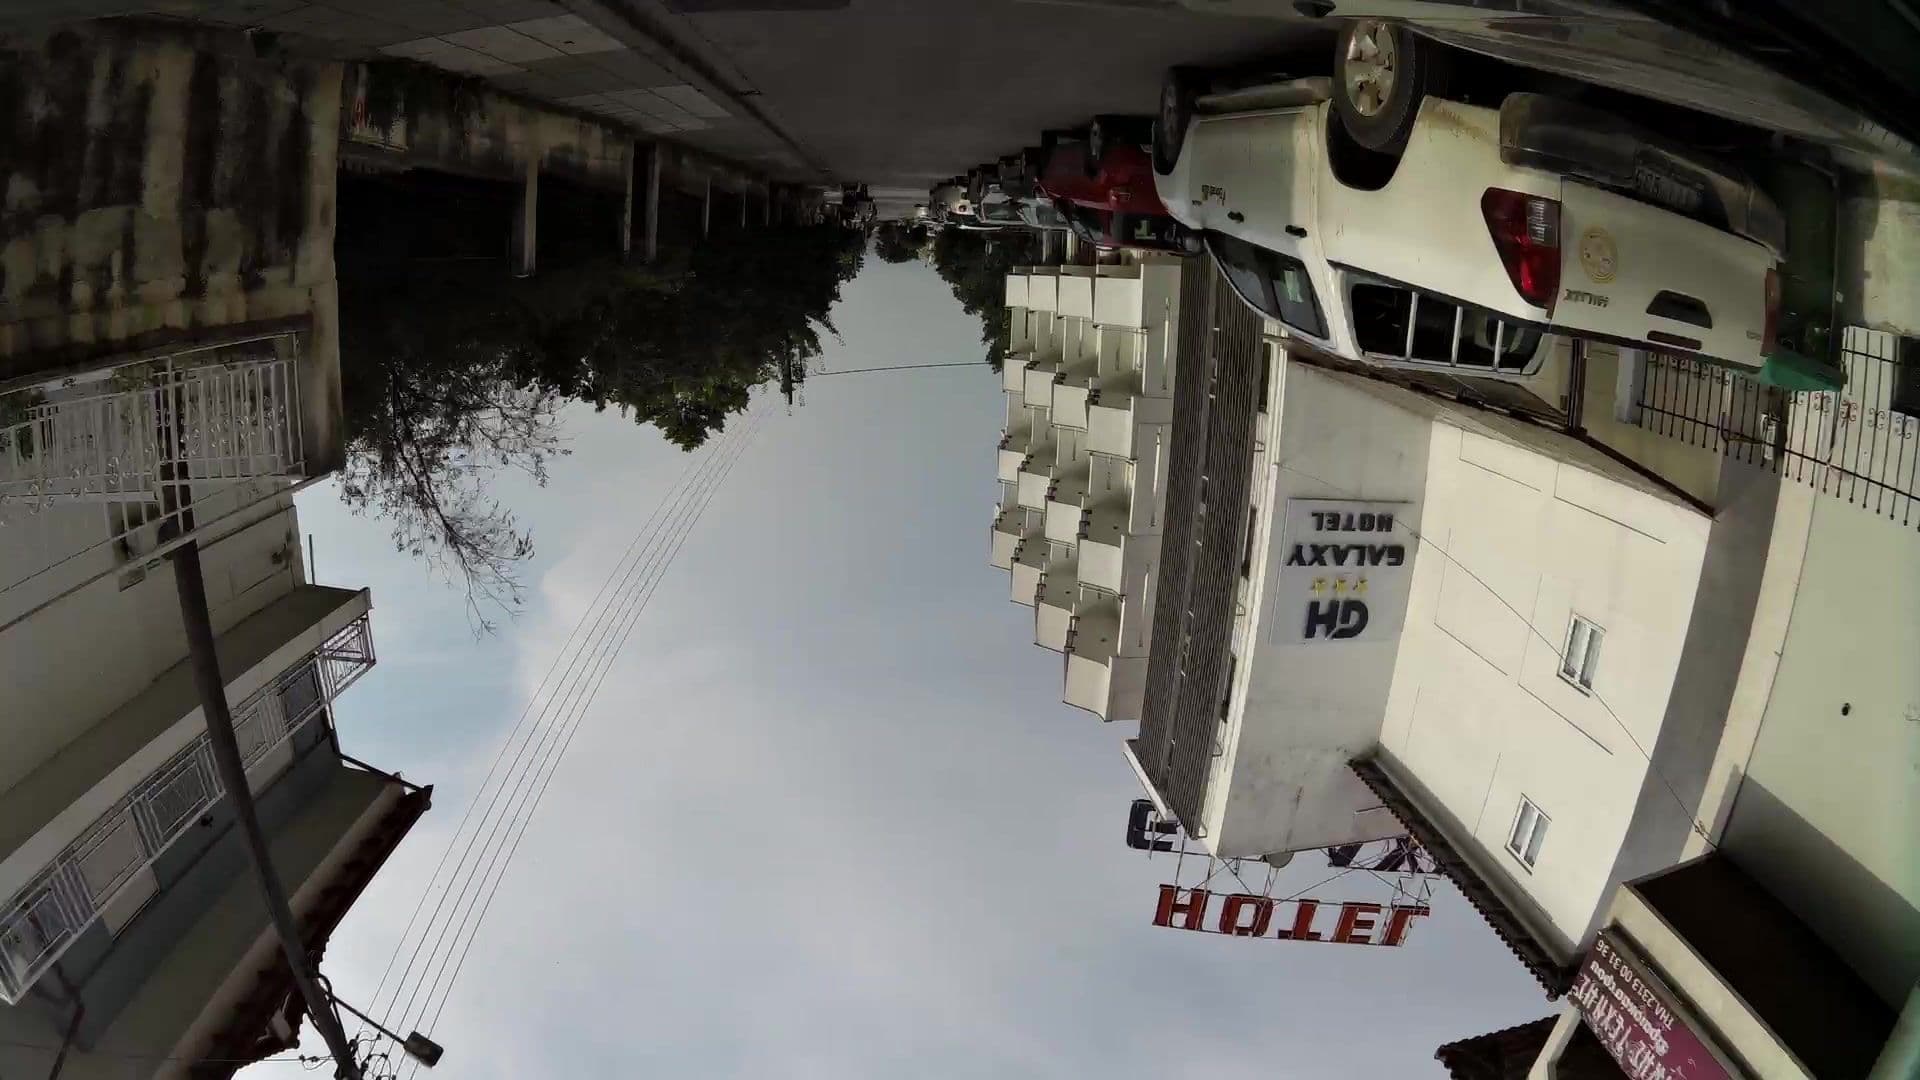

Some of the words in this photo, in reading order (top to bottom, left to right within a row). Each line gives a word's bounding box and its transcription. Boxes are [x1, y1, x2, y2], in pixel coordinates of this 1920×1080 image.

[1311, 511, 1394, 532] HOTEL
[1286, 543, 1405, 566] GALAXY
[1304, 599, 1369, 639] GH
[1596, 940, 1610, 957] 36
[1608, 952, 1621, 970] 31
[1620, 965, 1633, 983] 00
